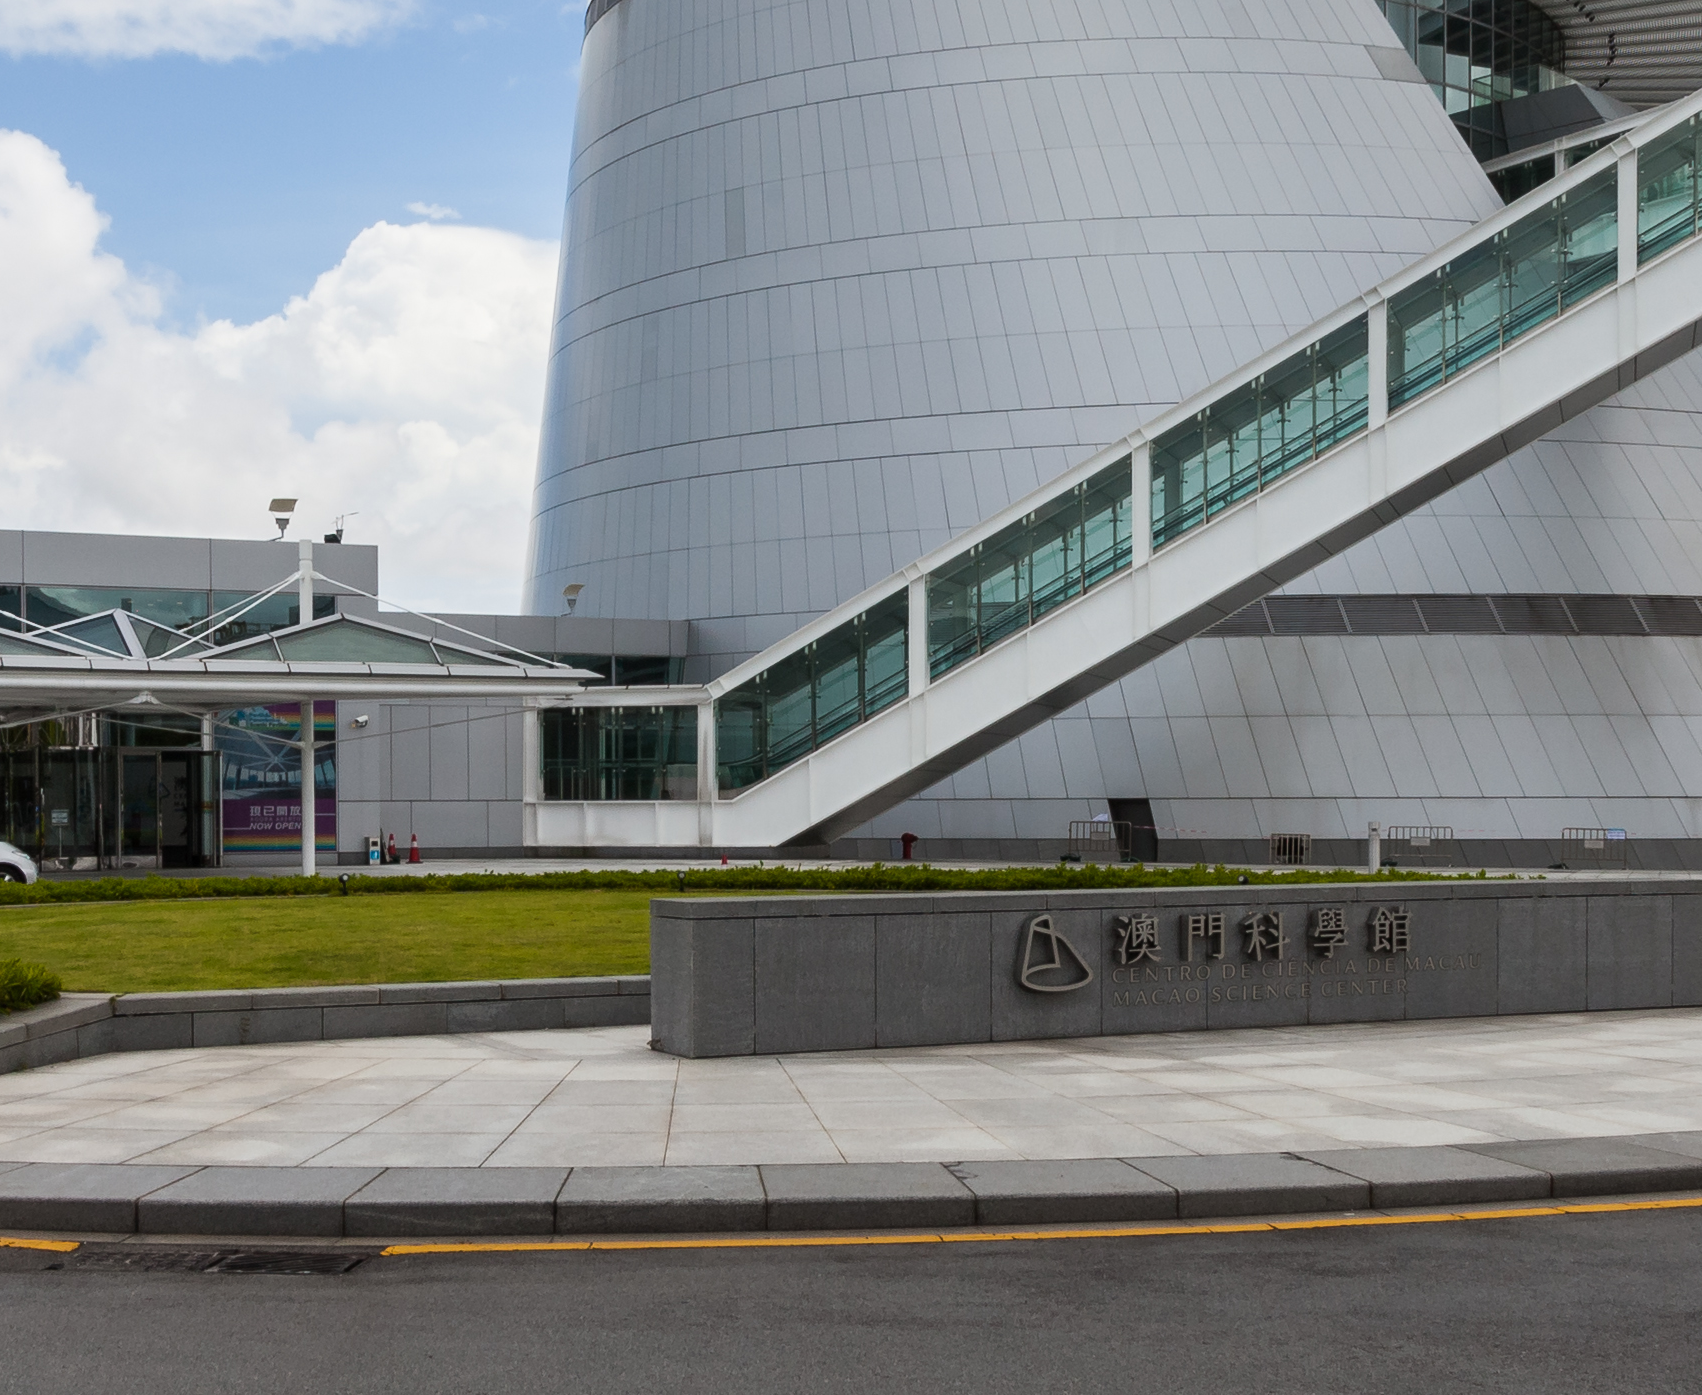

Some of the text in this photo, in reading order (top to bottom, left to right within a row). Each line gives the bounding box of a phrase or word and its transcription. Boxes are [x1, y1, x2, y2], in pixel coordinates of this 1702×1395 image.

[250, 806, 302, 816] 現已開放
[249, 822, 302, 830] NOW OPEN
[1116, 905, 1412, 964] 澳門科學館
[1112, 953, 1482, 985] CENTRO DE CIÊNCIA DE MACAU
[1112, 978, 1410, 1006] MACAO SCIENCE CENTER
